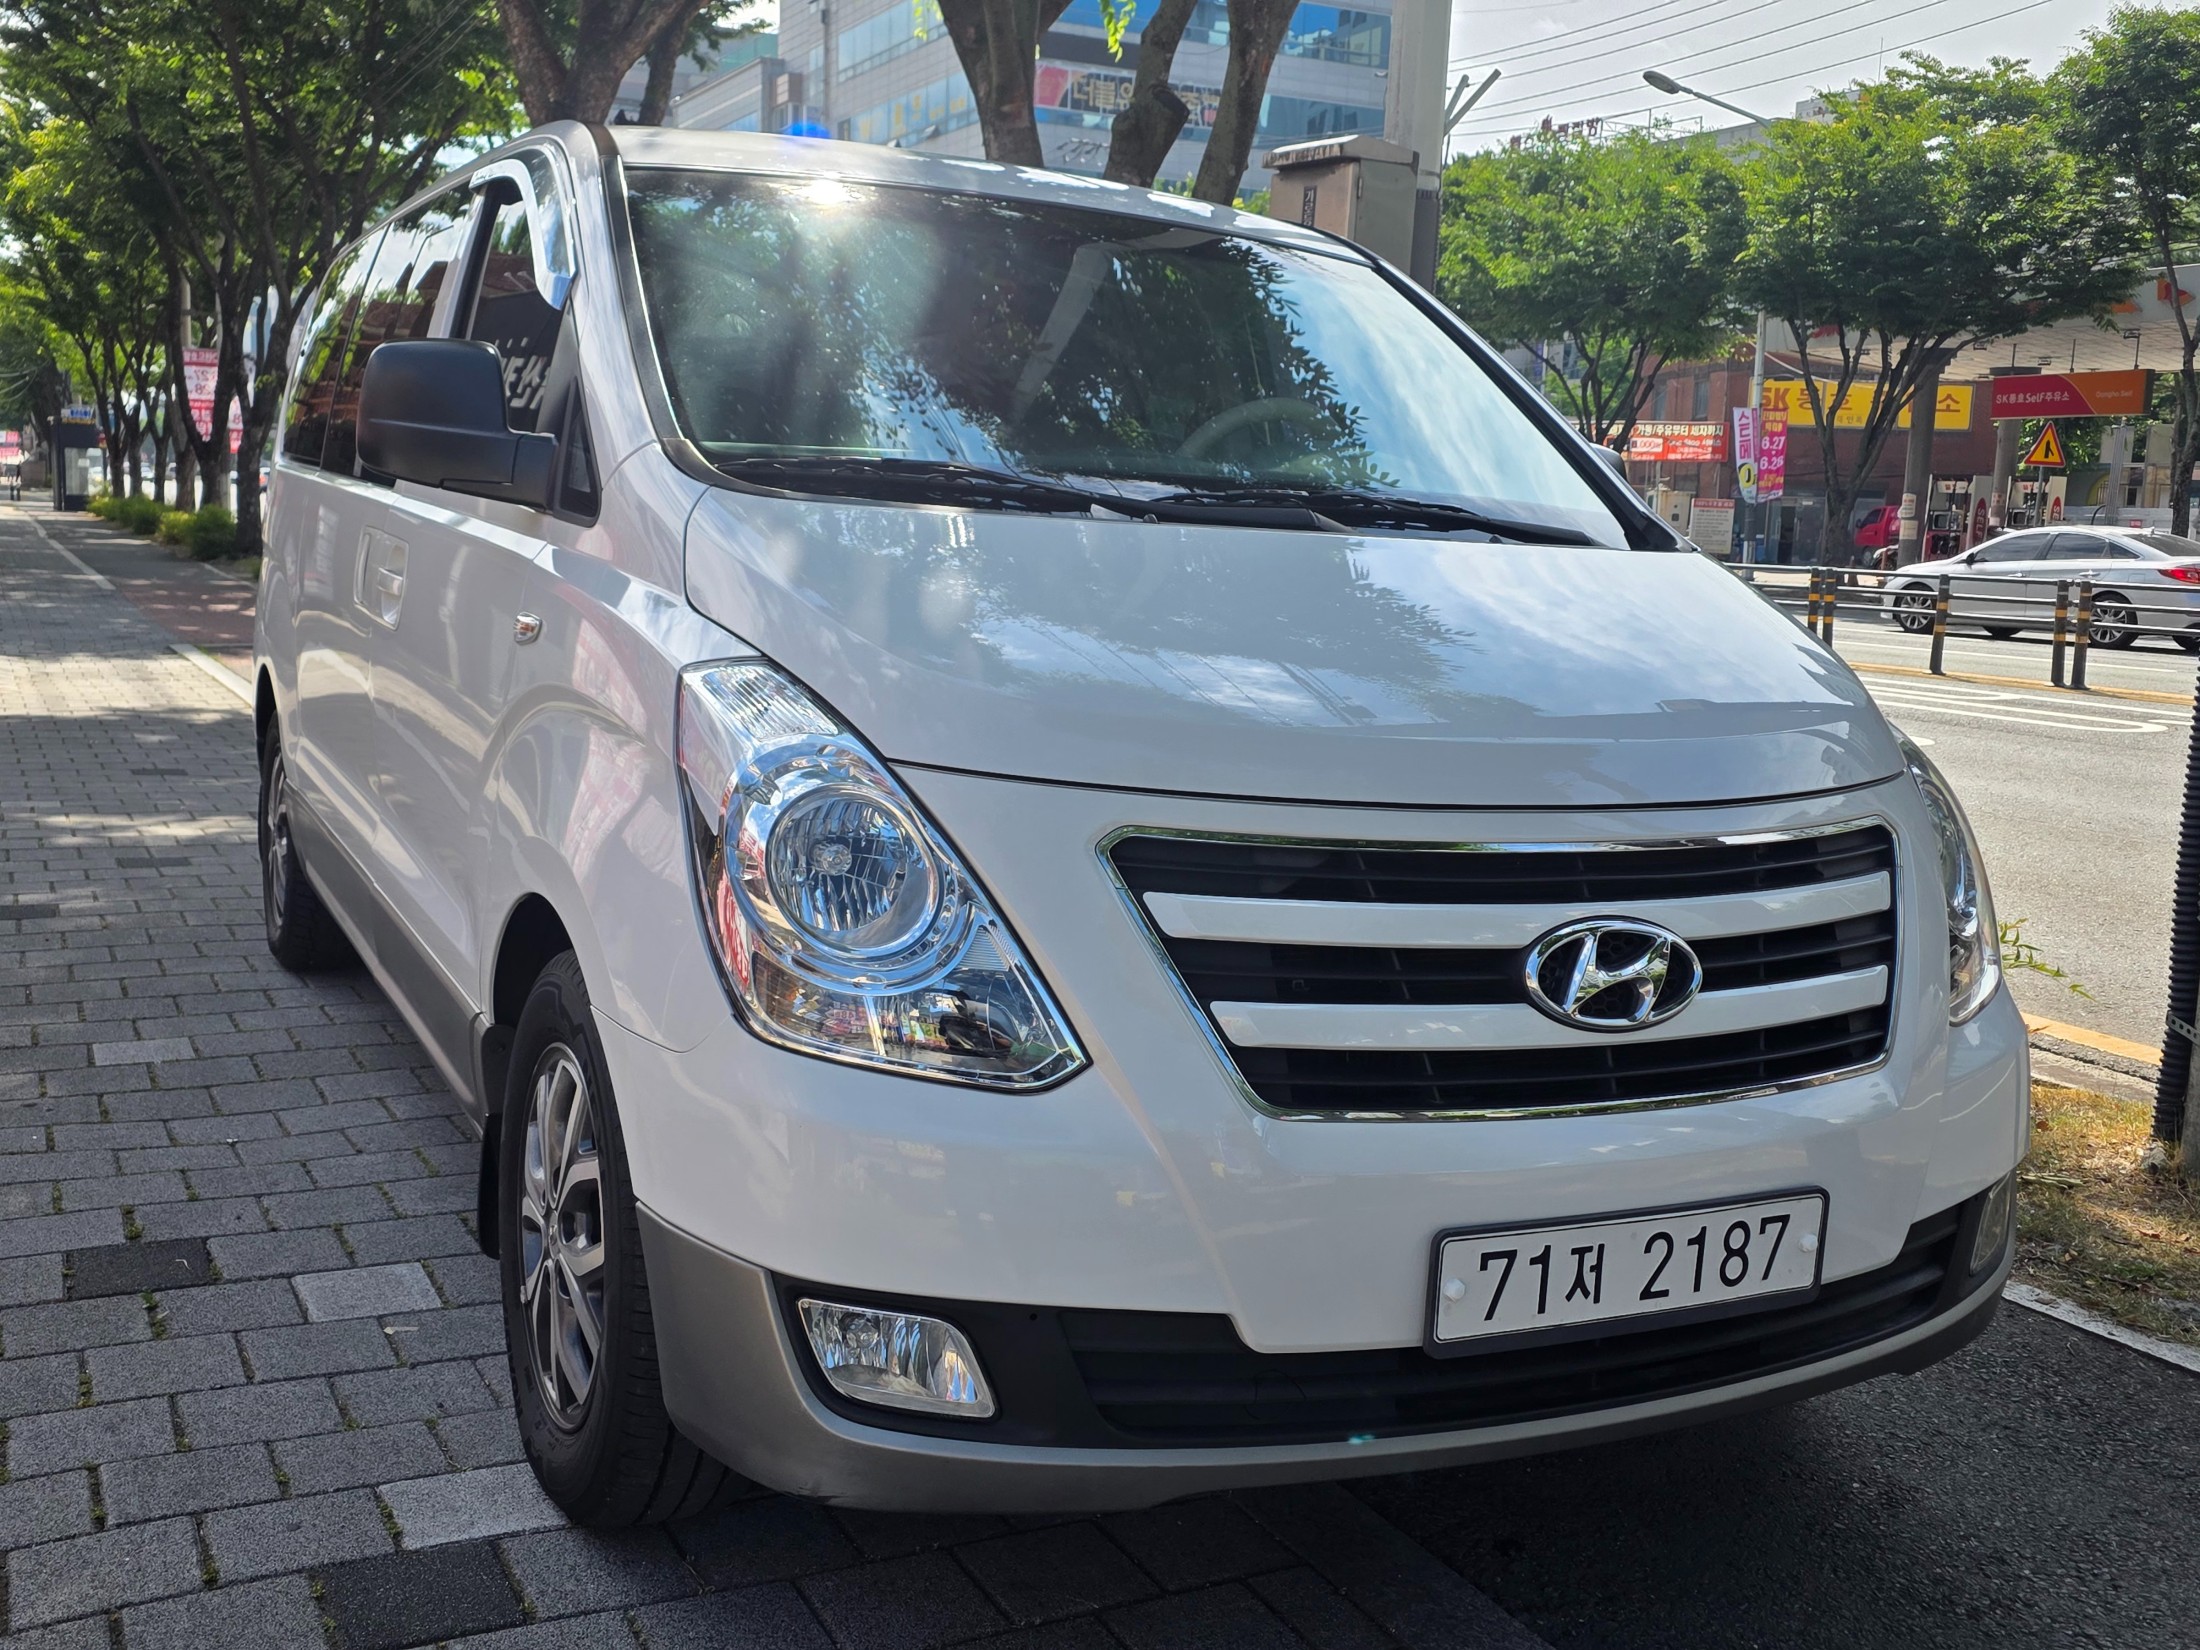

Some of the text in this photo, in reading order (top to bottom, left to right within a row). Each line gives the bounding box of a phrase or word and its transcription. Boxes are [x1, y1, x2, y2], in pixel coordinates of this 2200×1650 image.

[1761, 436, 1786, 450] 6.27
[1975, 507, 1985, 537] SELF
[1479, 1214, 1790, 1321] 71저 2187
